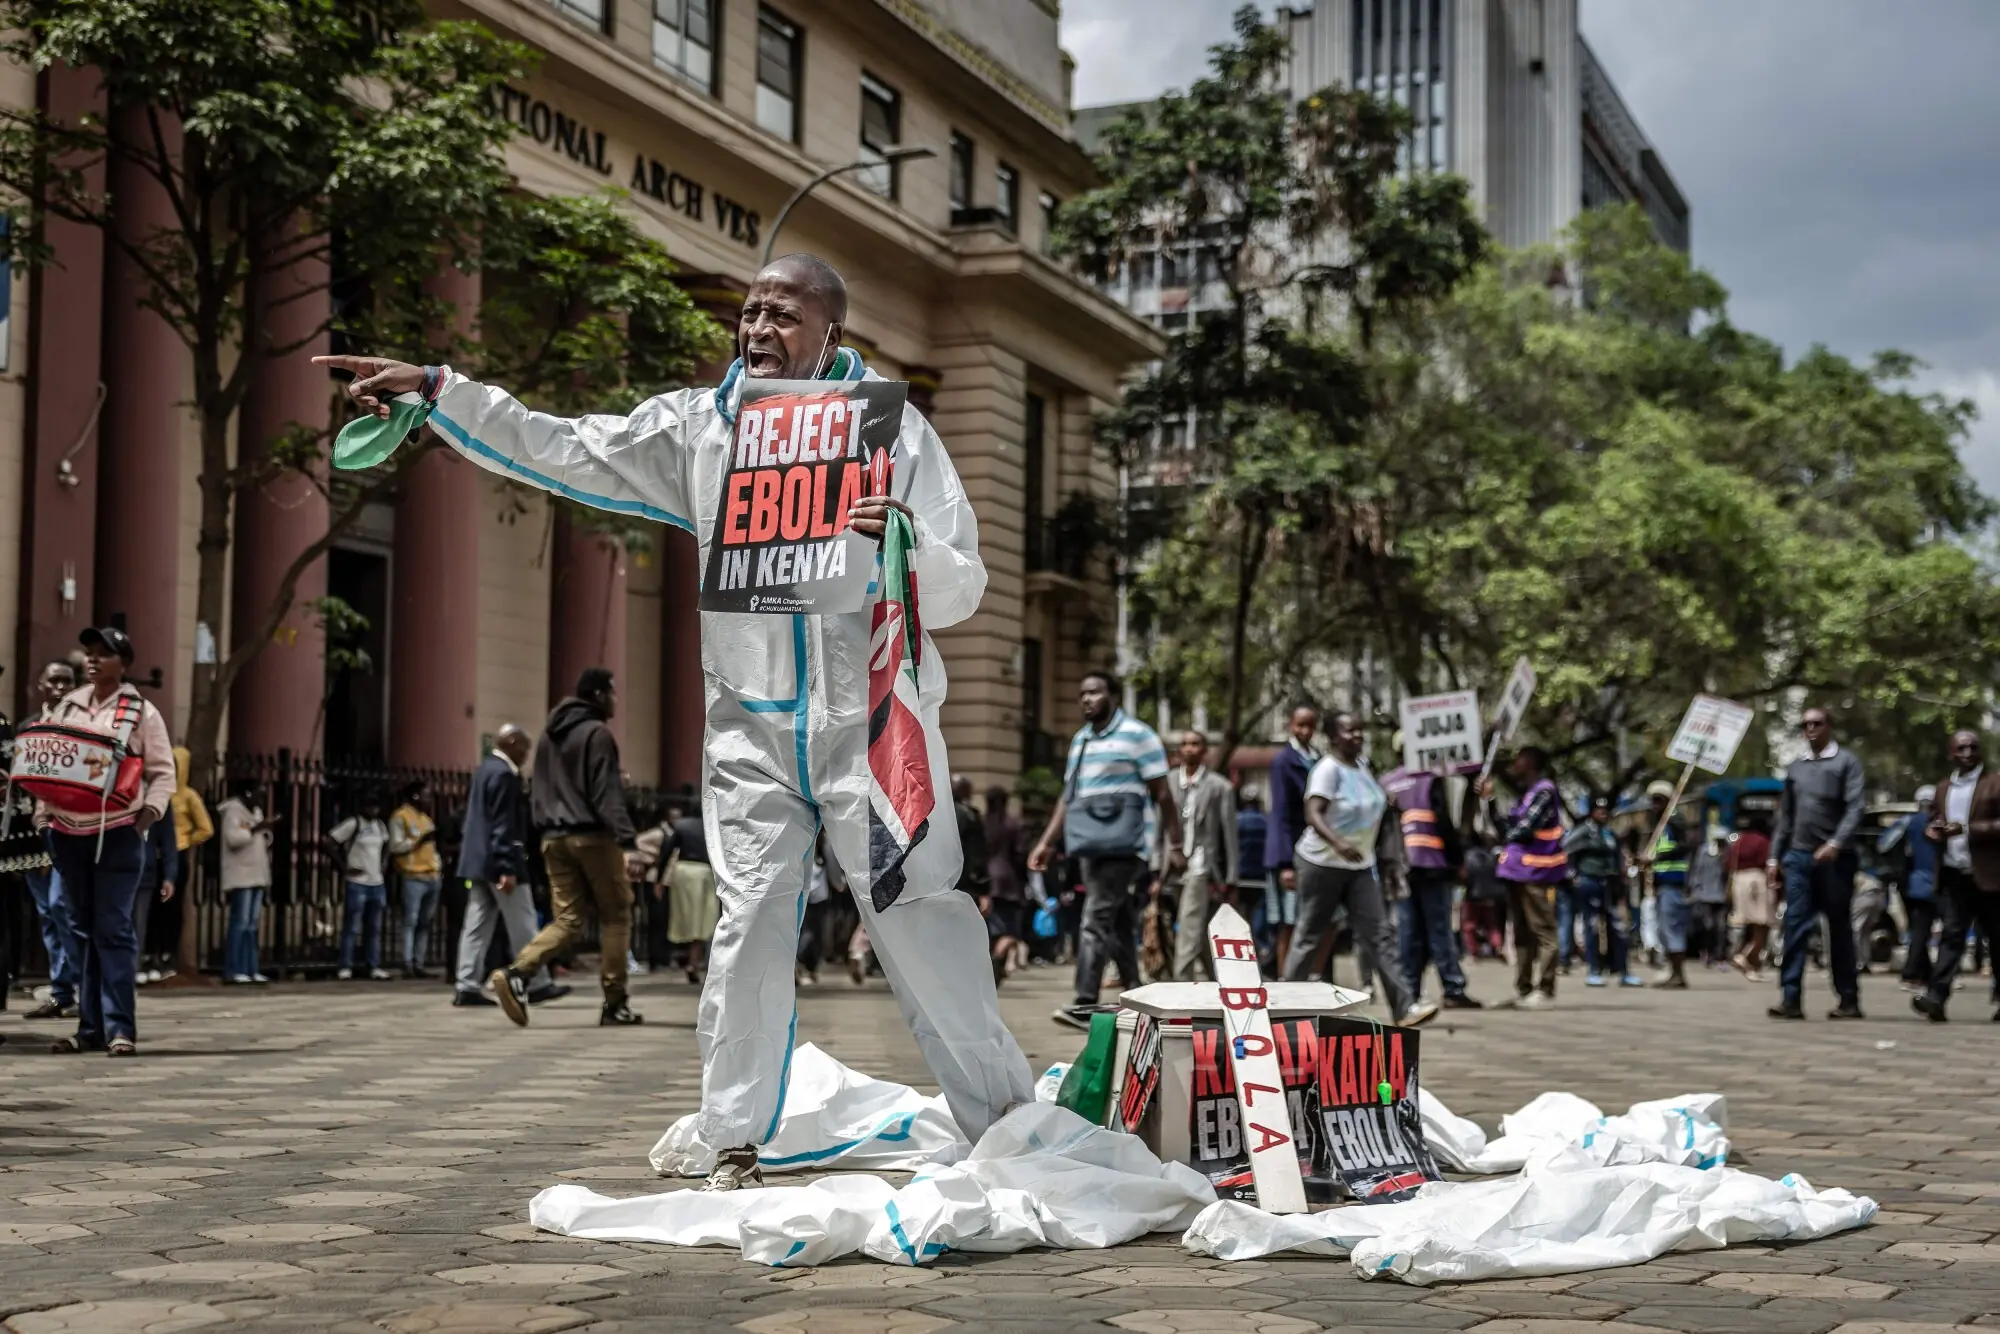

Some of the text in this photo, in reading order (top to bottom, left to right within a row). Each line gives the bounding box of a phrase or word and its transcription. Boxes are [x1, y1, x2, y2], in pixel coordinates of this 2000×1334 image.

[735, 398, 869, 469] REJECT
[723, 462, 863, 545] EBOLA
[718, 540, 847, 591] IN KENYA
[782, 598, 816, 606] Changamka!
[24, 739, 79, 757] SAMOSA
[24, 751, 74, 768] MOTO
[1212, 934, 1290, 1153] EBOLA
[1318, 1033, 1407, 1107] KATAA
[1197, 1089, 1309, 1161] EBA
[1323, 1105, 1415, 1171] EBOLA
